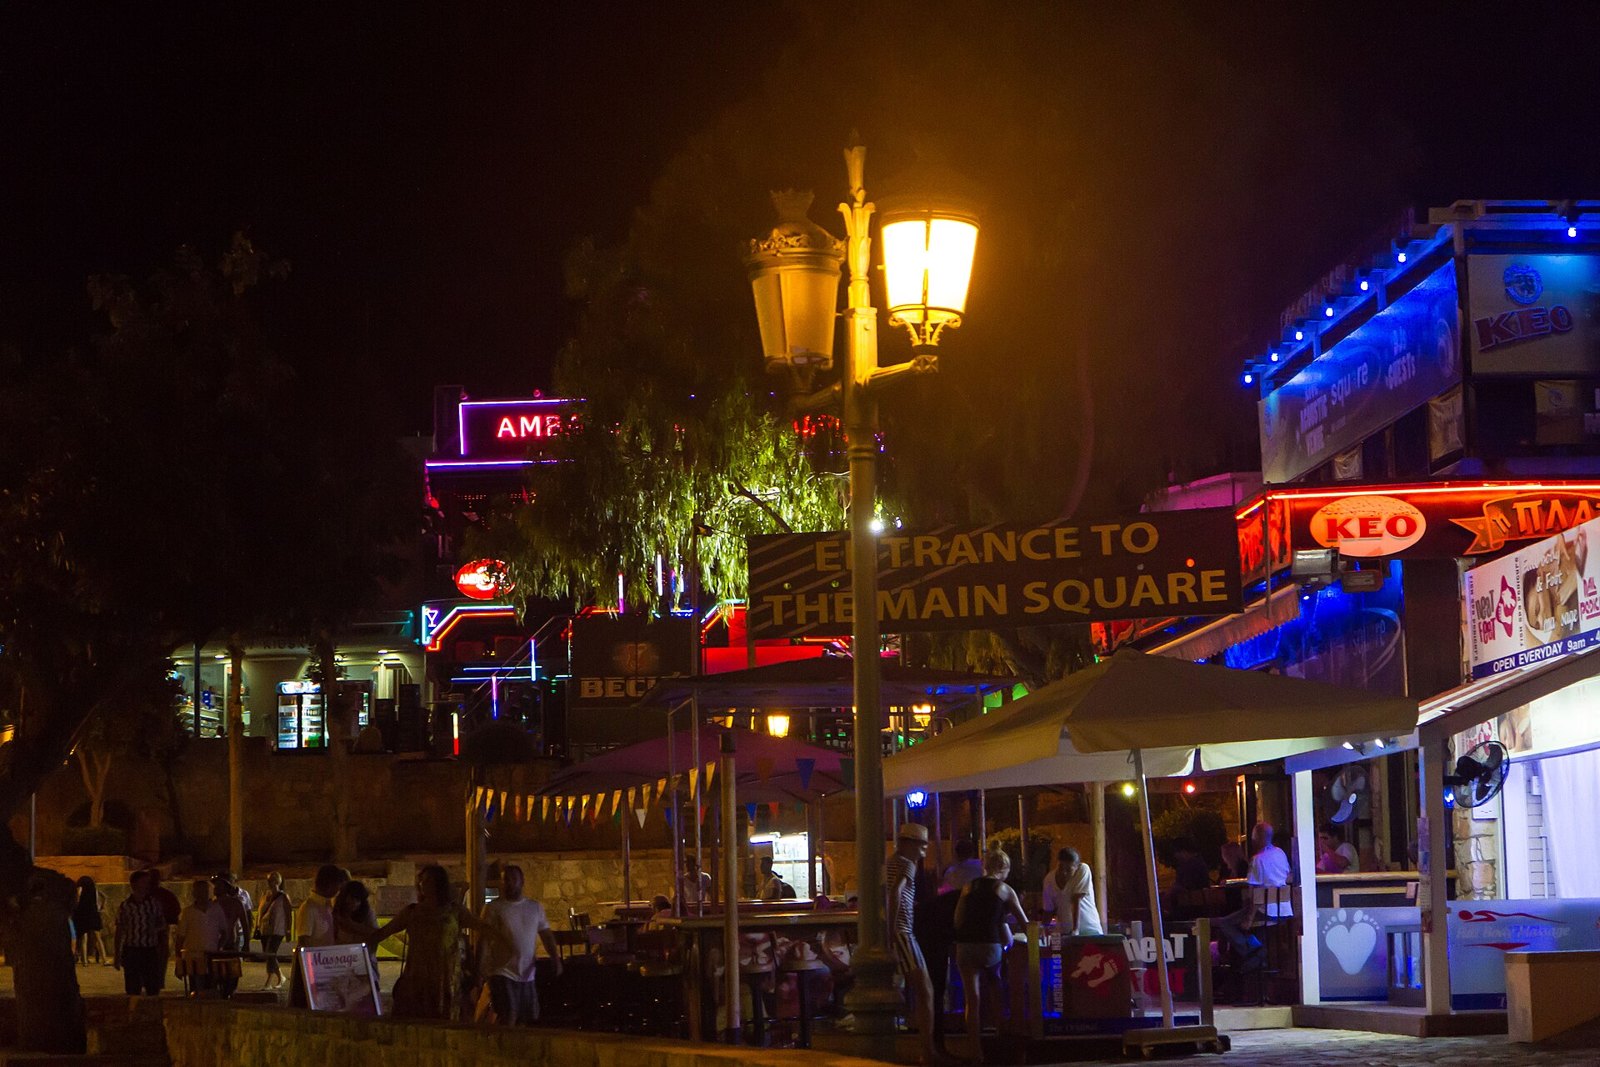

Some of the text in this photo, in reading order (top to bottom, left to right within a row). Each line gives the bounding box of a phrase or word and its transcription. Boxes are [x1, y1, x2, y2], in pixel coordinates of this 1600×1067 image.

[1474, 305, 1572, 352] KEO
[1326, 514, 1417, 540] KEO
[1512, 499, 1600, 533] ΠΛΑ
[815, 520, 1159, 571] ETRANCE TO
[878, 584, 1008, 622] MAIN
[1023, 569, 1229, 615] SQUARE
[1493, 656, 1516, 673] OPEN
[1518, 642, 1564, 665] EVERYDAY
[1567, 638, 1586, 652] 9am
[580, 677, 657, 699] BEC
[313, 952, 359, 968] Massage
